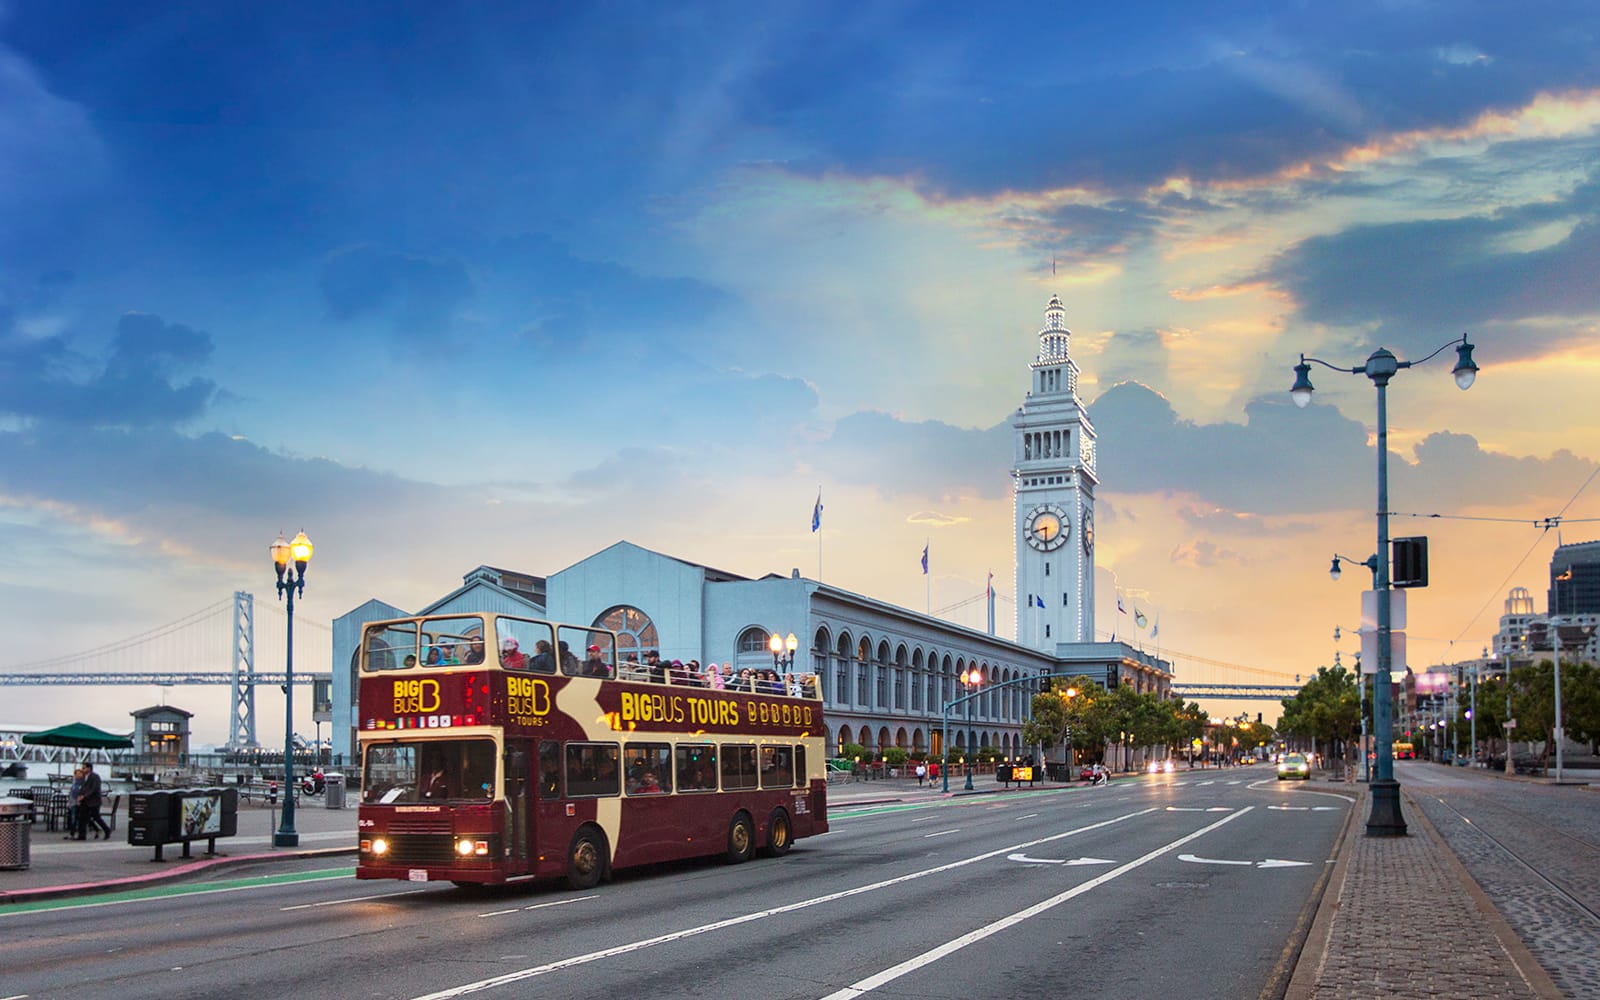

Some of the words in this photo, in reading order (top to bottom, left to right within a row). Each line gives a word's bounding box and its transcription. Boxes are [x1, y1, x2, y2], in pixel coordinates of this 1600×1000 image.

[394, 680, 419, 698] BIG
[507, 676, 531, 697] BIG
[394, 698, 418, 714] BUS
[508, 696, 532, 715] BUS
[687, 697, 739, 726] TOURS
[517, 716, 543, 727] TOURS
